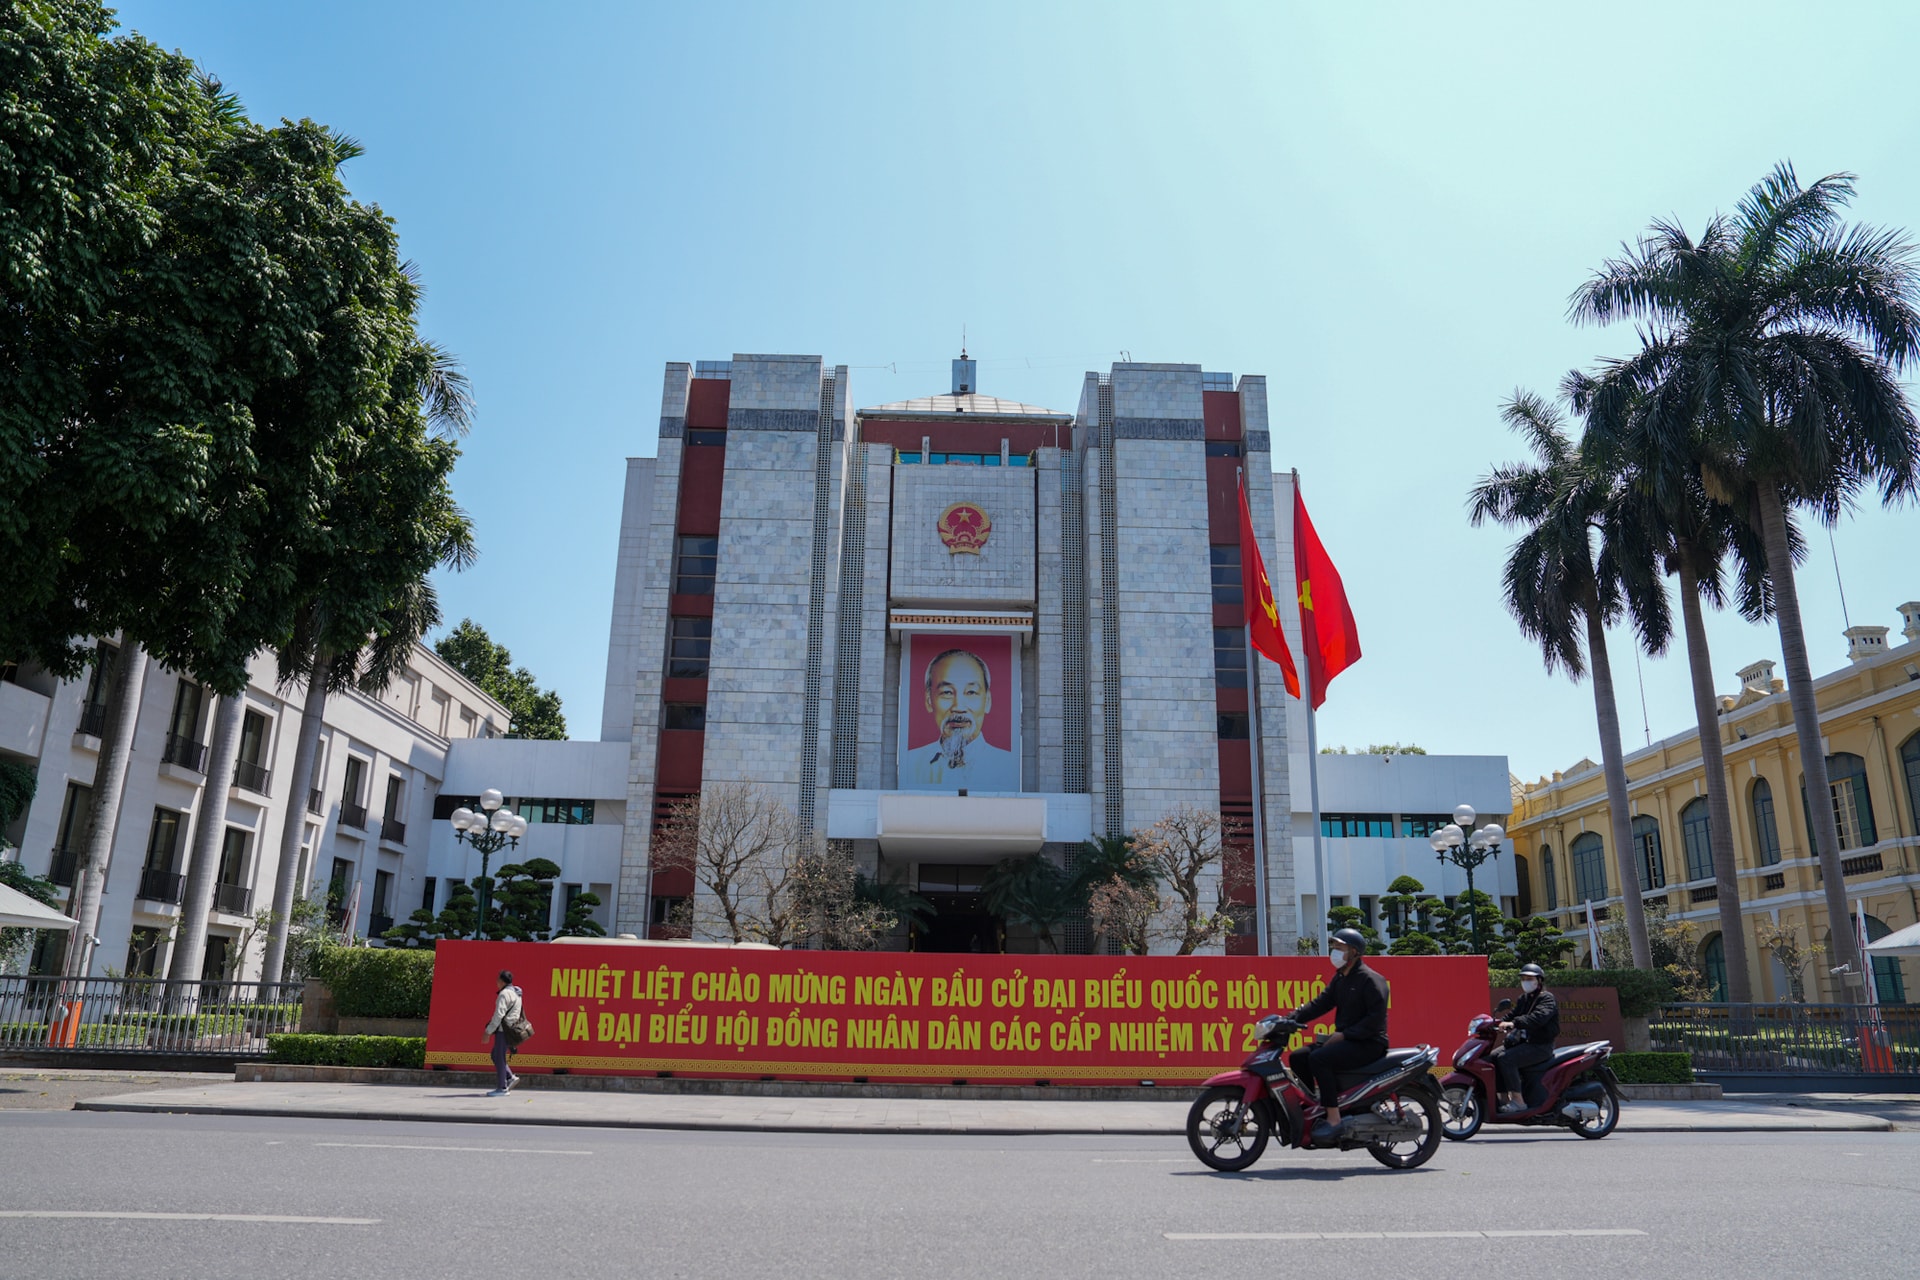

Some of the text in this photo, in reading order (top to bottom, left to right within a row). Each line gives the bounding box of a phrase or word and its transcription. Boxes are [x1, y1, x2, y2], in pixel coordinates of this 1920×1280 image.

[551, 963, 1326, 1015] NHIỆT LIỆT CHÀO MỪNG NGÀY BẦU CỬ ĐẠI BIỂU QUỐC HỘI KHÓ
[558, 1005, 589, 1041] VÀ
[598, 1013, 641, 1048] ĐẠI
[649, 1003, 708, 1044] BIỂU
[716, 1009, 758, 1052] HỘI
[767, 1009, 838, 1048] ĐỒNG
[847, 1014, 918, 1049] NHÂN
[928, 1015, 981, 1050] DÂN
[990, 1015, 1040, 1051] CÁC
[1050, 1012, 1101, 1051] CẤP
[1110, 1016, 1193, 1058] NHIỆM
[1202, 1017, 1233, 1052] KỲ
